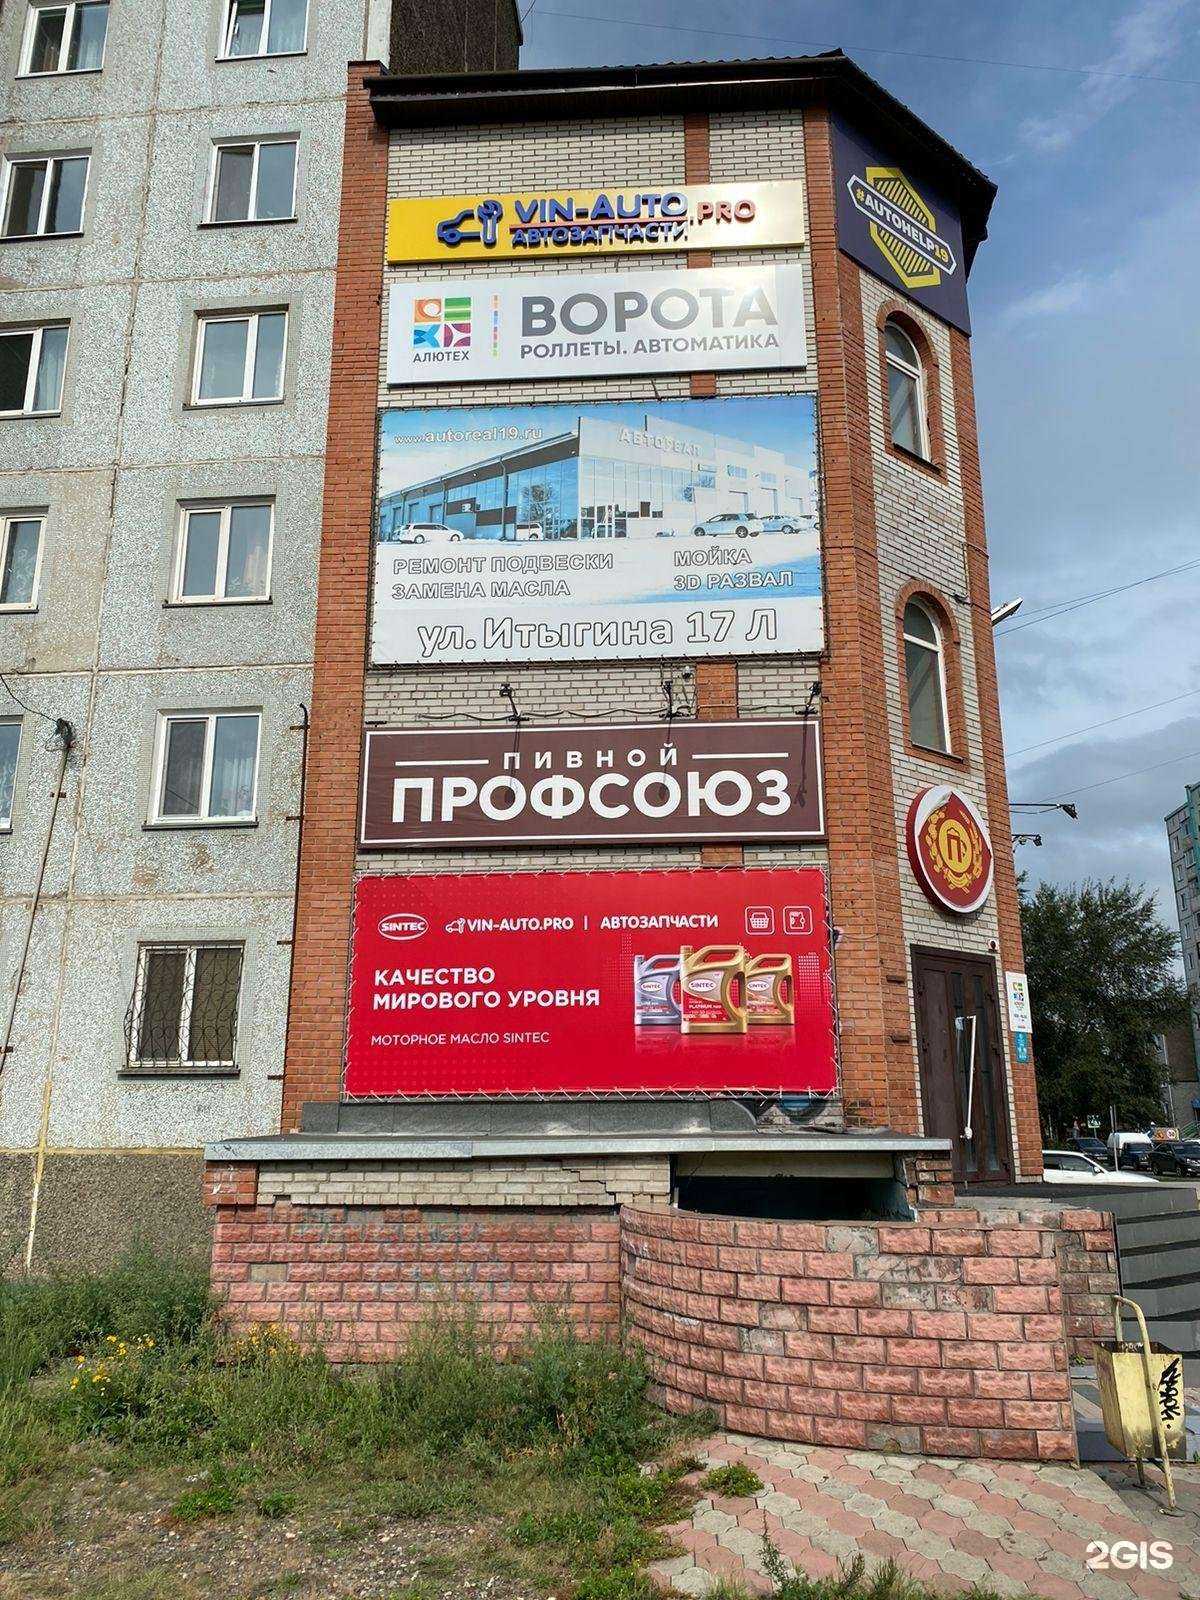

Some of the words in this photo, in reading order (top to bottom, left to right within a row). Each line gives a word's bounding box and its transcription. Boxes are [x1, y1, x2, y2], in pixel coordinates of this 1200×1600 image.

[511, 222, 689, 248] АВТОЗАПЧАСТИ
[520, 287, 779, 338] ВОРОТА
[413, 350, 470, 364] АЛЮТЕХ
[520, 343, 627, 360] РОЛЛЕТЫ.
[633, 333, 780, 355] АВТОМАТИКА
[393, 424, 544, 445] www.autoreal19.ru
[393, 557, 486, 575] РЕМОНТ
[490, 553, 614, 574] ПОДВЕСКИ
[674, 545, 752, 567] МОЙКА
[391, 581, 486, 600] ЗАМЕНА
[490, 579, 571, 598] МАСЛА
[673, 574, 702, 591] 3D
[707, 570, 794, 590] РАЗВАЛ
[417, 625, 477, 658] ул.
[483, 616, 674, 650] Итыгина
[686, 610, 736, 644] 17
[745, 608, 778, 641] Л
[503, 743, 679, 770] ПИВНОЙ
[391, 768, 793, 823] ПРОФСОЮЗ
[381, 920, 426, 934] SINTEC
[467, 916, 575, 932] VIN-AUTO.PRO
[600, 914, 720, 930] АВТОЗАПЧАСТИ
[374, 966, 496, 987] КАЧЕСТВО
[690, 981, 715, 989] SINTEC
[373, 991, 501, 1010] МИРОВОГО
[508, 988, 600, 1009] УРОВНЯ
[371, 1034, 447, 1046] МОТОРНОЕ
[450, 1033, 500, 1045] МАСЛО
[503, 1032, 550, 1044] SINTEC
